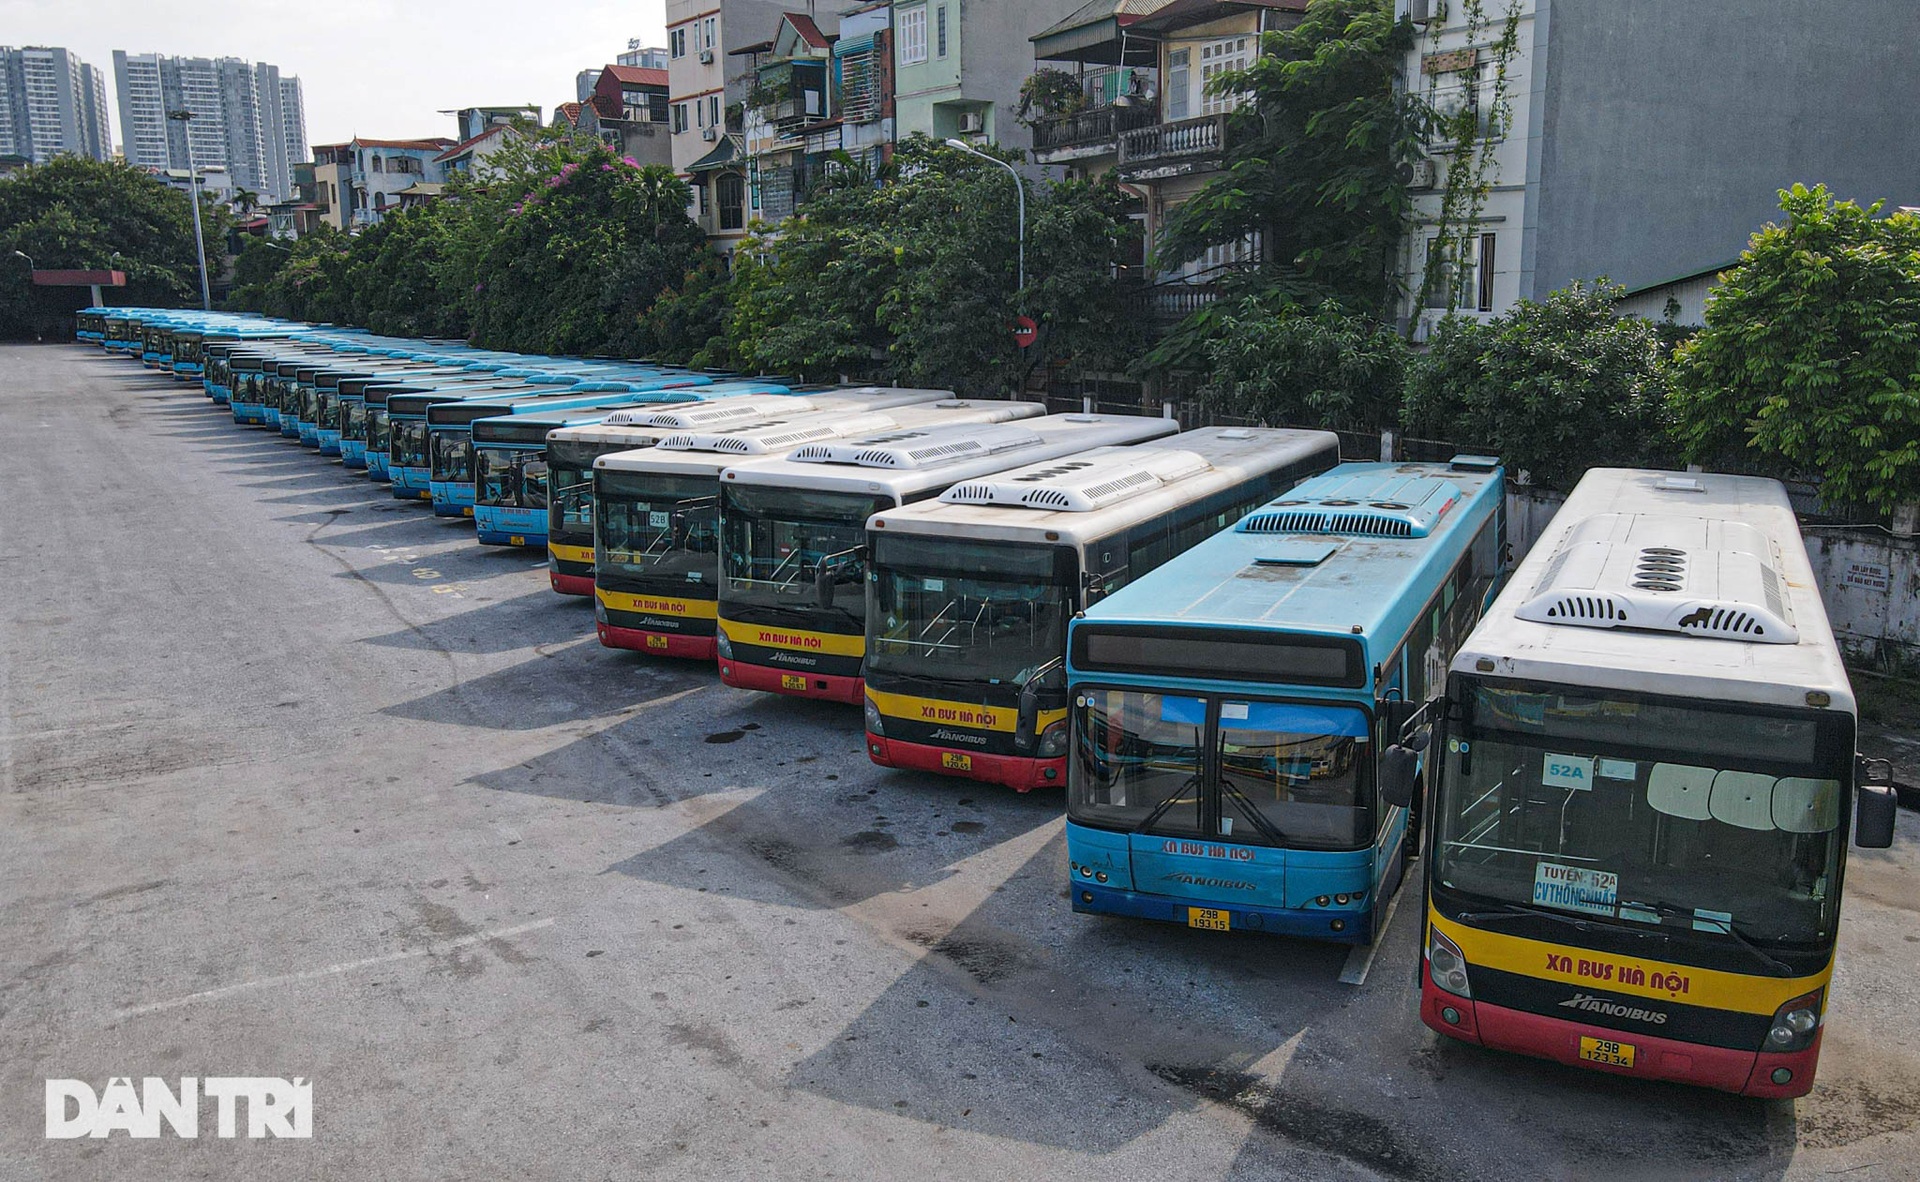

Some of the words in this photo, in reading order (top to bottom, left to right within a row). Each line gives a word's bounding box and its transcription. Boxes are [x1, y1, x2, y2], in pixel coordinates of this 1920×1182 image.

[650, 514, 666, 524] 52B
[644, 600, 658, 609] BUS
[772, 633, 788, 644] BUS
[769, 651, 817, 666] HANOIBUS
[938, 708, 957, 720] BUS
[929, 728, 988, 745] HANOIBUS
[1549, 763, 1584, 779] 52A
[1180, 842, 1204, 856] BUS
[1199, 909, 1218, 919] 29B
[1193, 918, 1226, 930] 193.15
[1577, 959, 1614, 981] BUS
[1618, 964, 1646, 986] HÀ
[1650, 971, 1690, 998] NỘI
[1558, 993, 1668, 1024] HANOIBUS
[1595, 1040, 1620, 1054] 29B
[1586, 1051, 1628, 1066] 123.34
